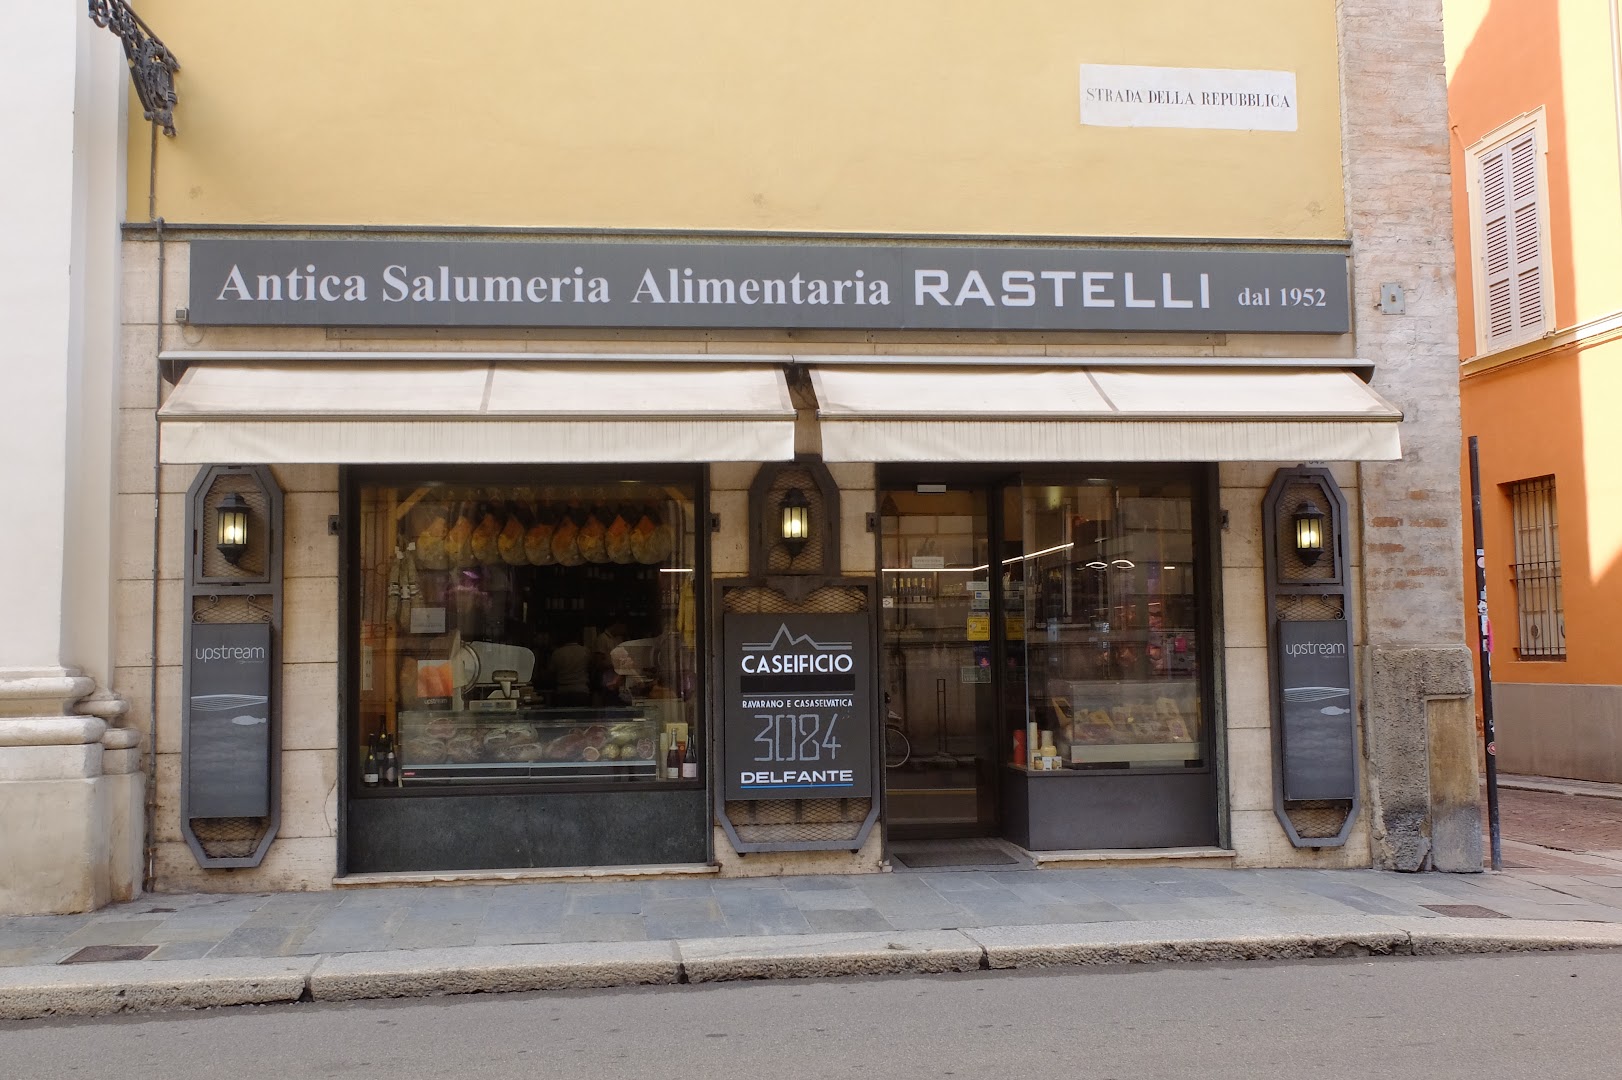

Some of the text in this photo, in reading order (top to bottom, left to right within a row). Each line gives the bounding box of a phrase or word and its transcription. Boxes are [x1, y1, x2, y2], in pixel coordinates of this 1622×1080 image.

[1086, 88, 1290, 108] STRADA DELLA REPUBBLICA
[217, 264, 1326, 309] Antica Salumeria Alimentaria RASTELLI dal 1952
[195, 645, 265, 662] upstream
[1285, 641, 1345, 658] upstream
[742, 654, 852, 673] CASEIFICIO
[742, 698, 853, 709] RAVARANO E CASASELVATICA
[754, 713, 841, 761] 3084
[740, 769, 853, 784] DELFANTE
